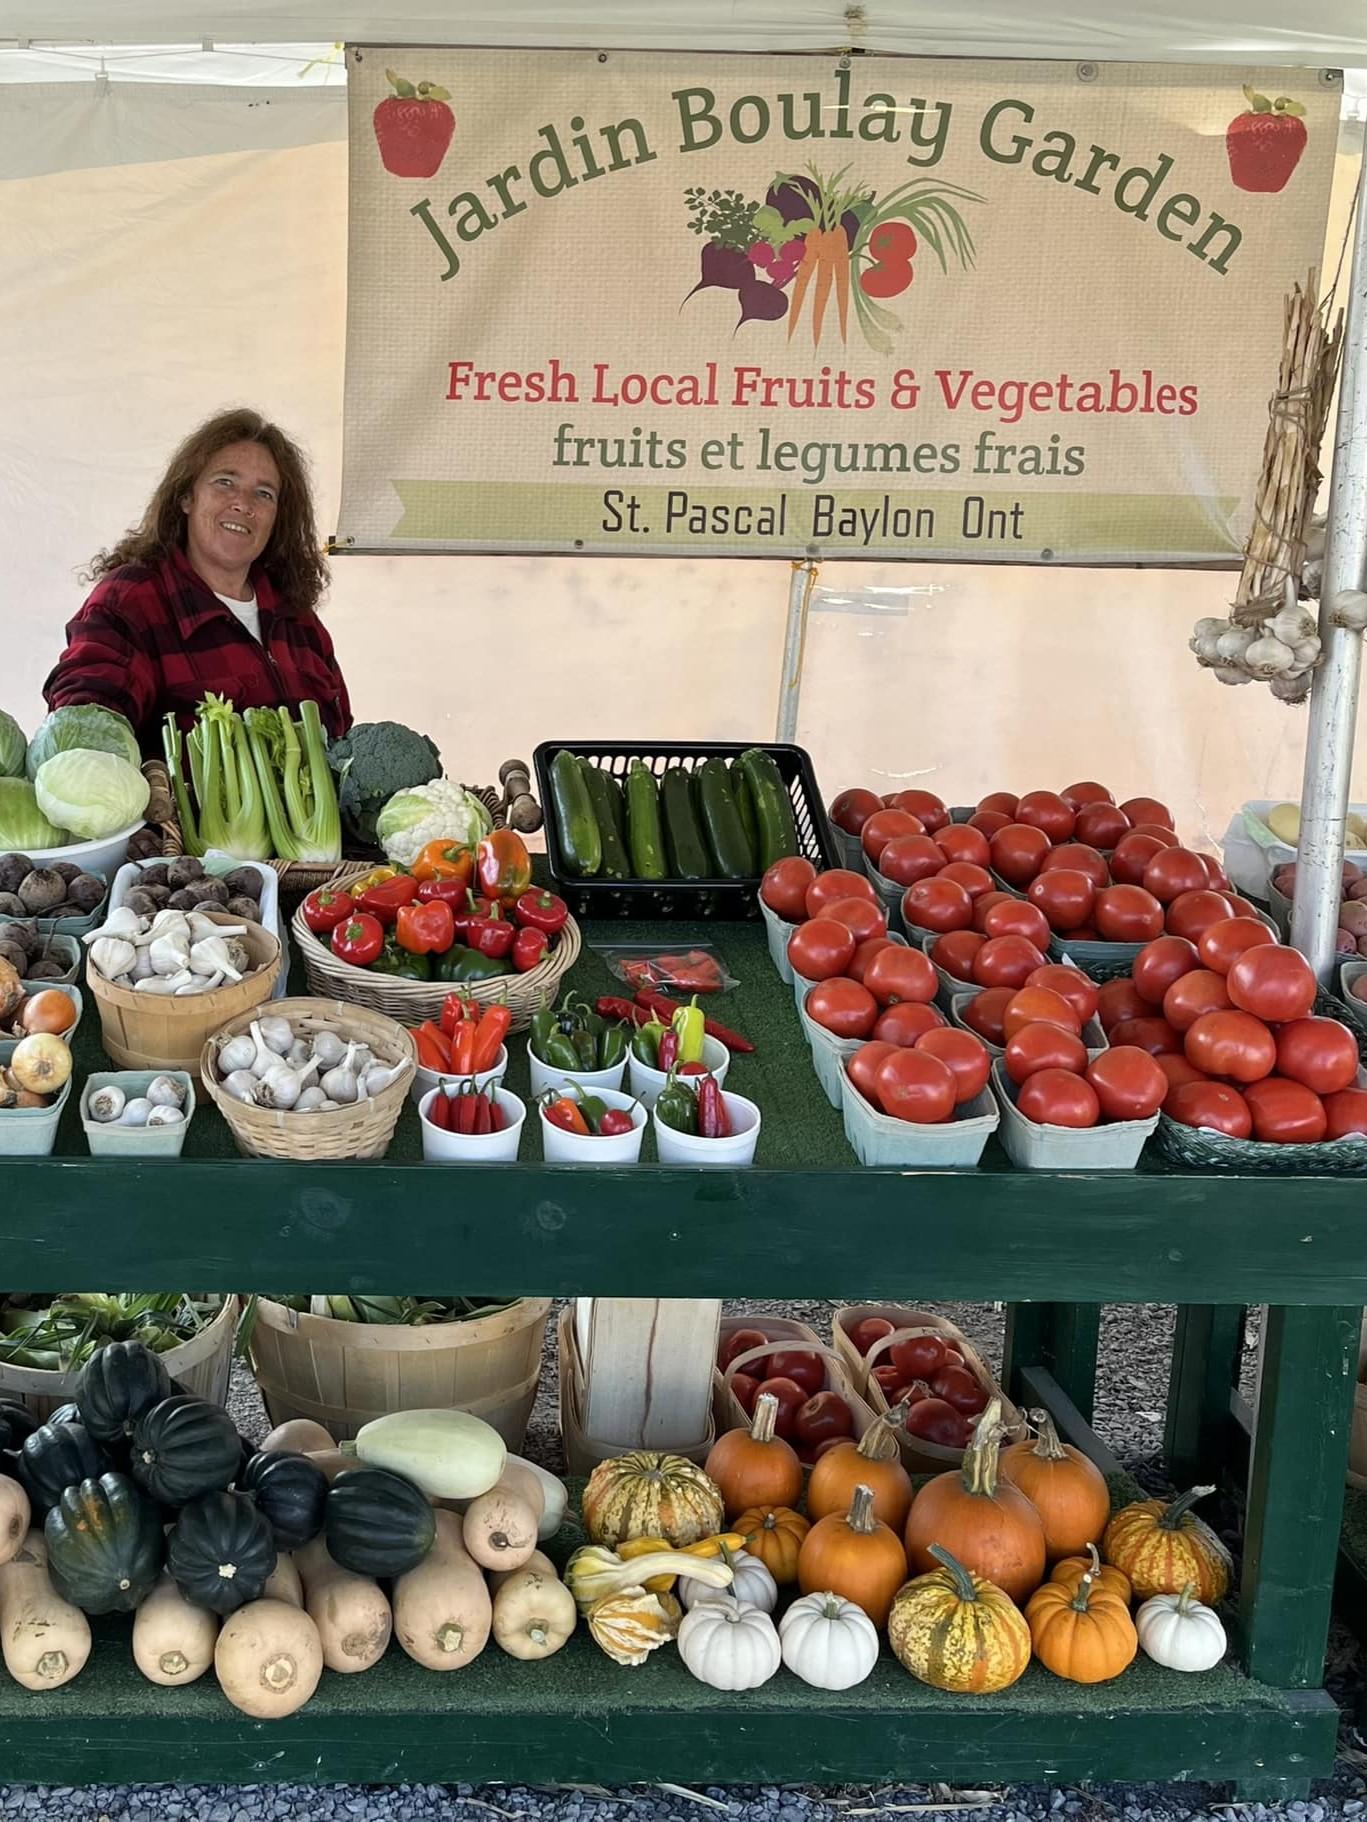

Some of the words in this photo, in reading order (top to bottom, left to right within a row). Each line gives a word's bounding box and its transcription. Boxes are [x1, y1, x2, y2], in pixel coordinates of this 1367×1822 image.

[409, 114, 658, 281] Jardin
[670, 69, 954, 167] Boulay
[978, 98, 1244, 276] Garden
[446, 359, 578, 403] Fresh
[592, 362, 718, 406] Local
[731, 366, 876, 409] Fruits
[890, 368, 921, 409] &
[934, 369, 1199, 423] Vegetables
[553, 423, 687, 470] fruits
[700, 432, 744, 470] et
[757, 428, 961, 485] legumes
[973, 430, 1086, 476] frais
[601, 489, 650, 534] St.
[665, 491, 787, 536] Pascal
[813, 493, 935, 544] Baylon
[961, 497, 1026, 540] Ont
